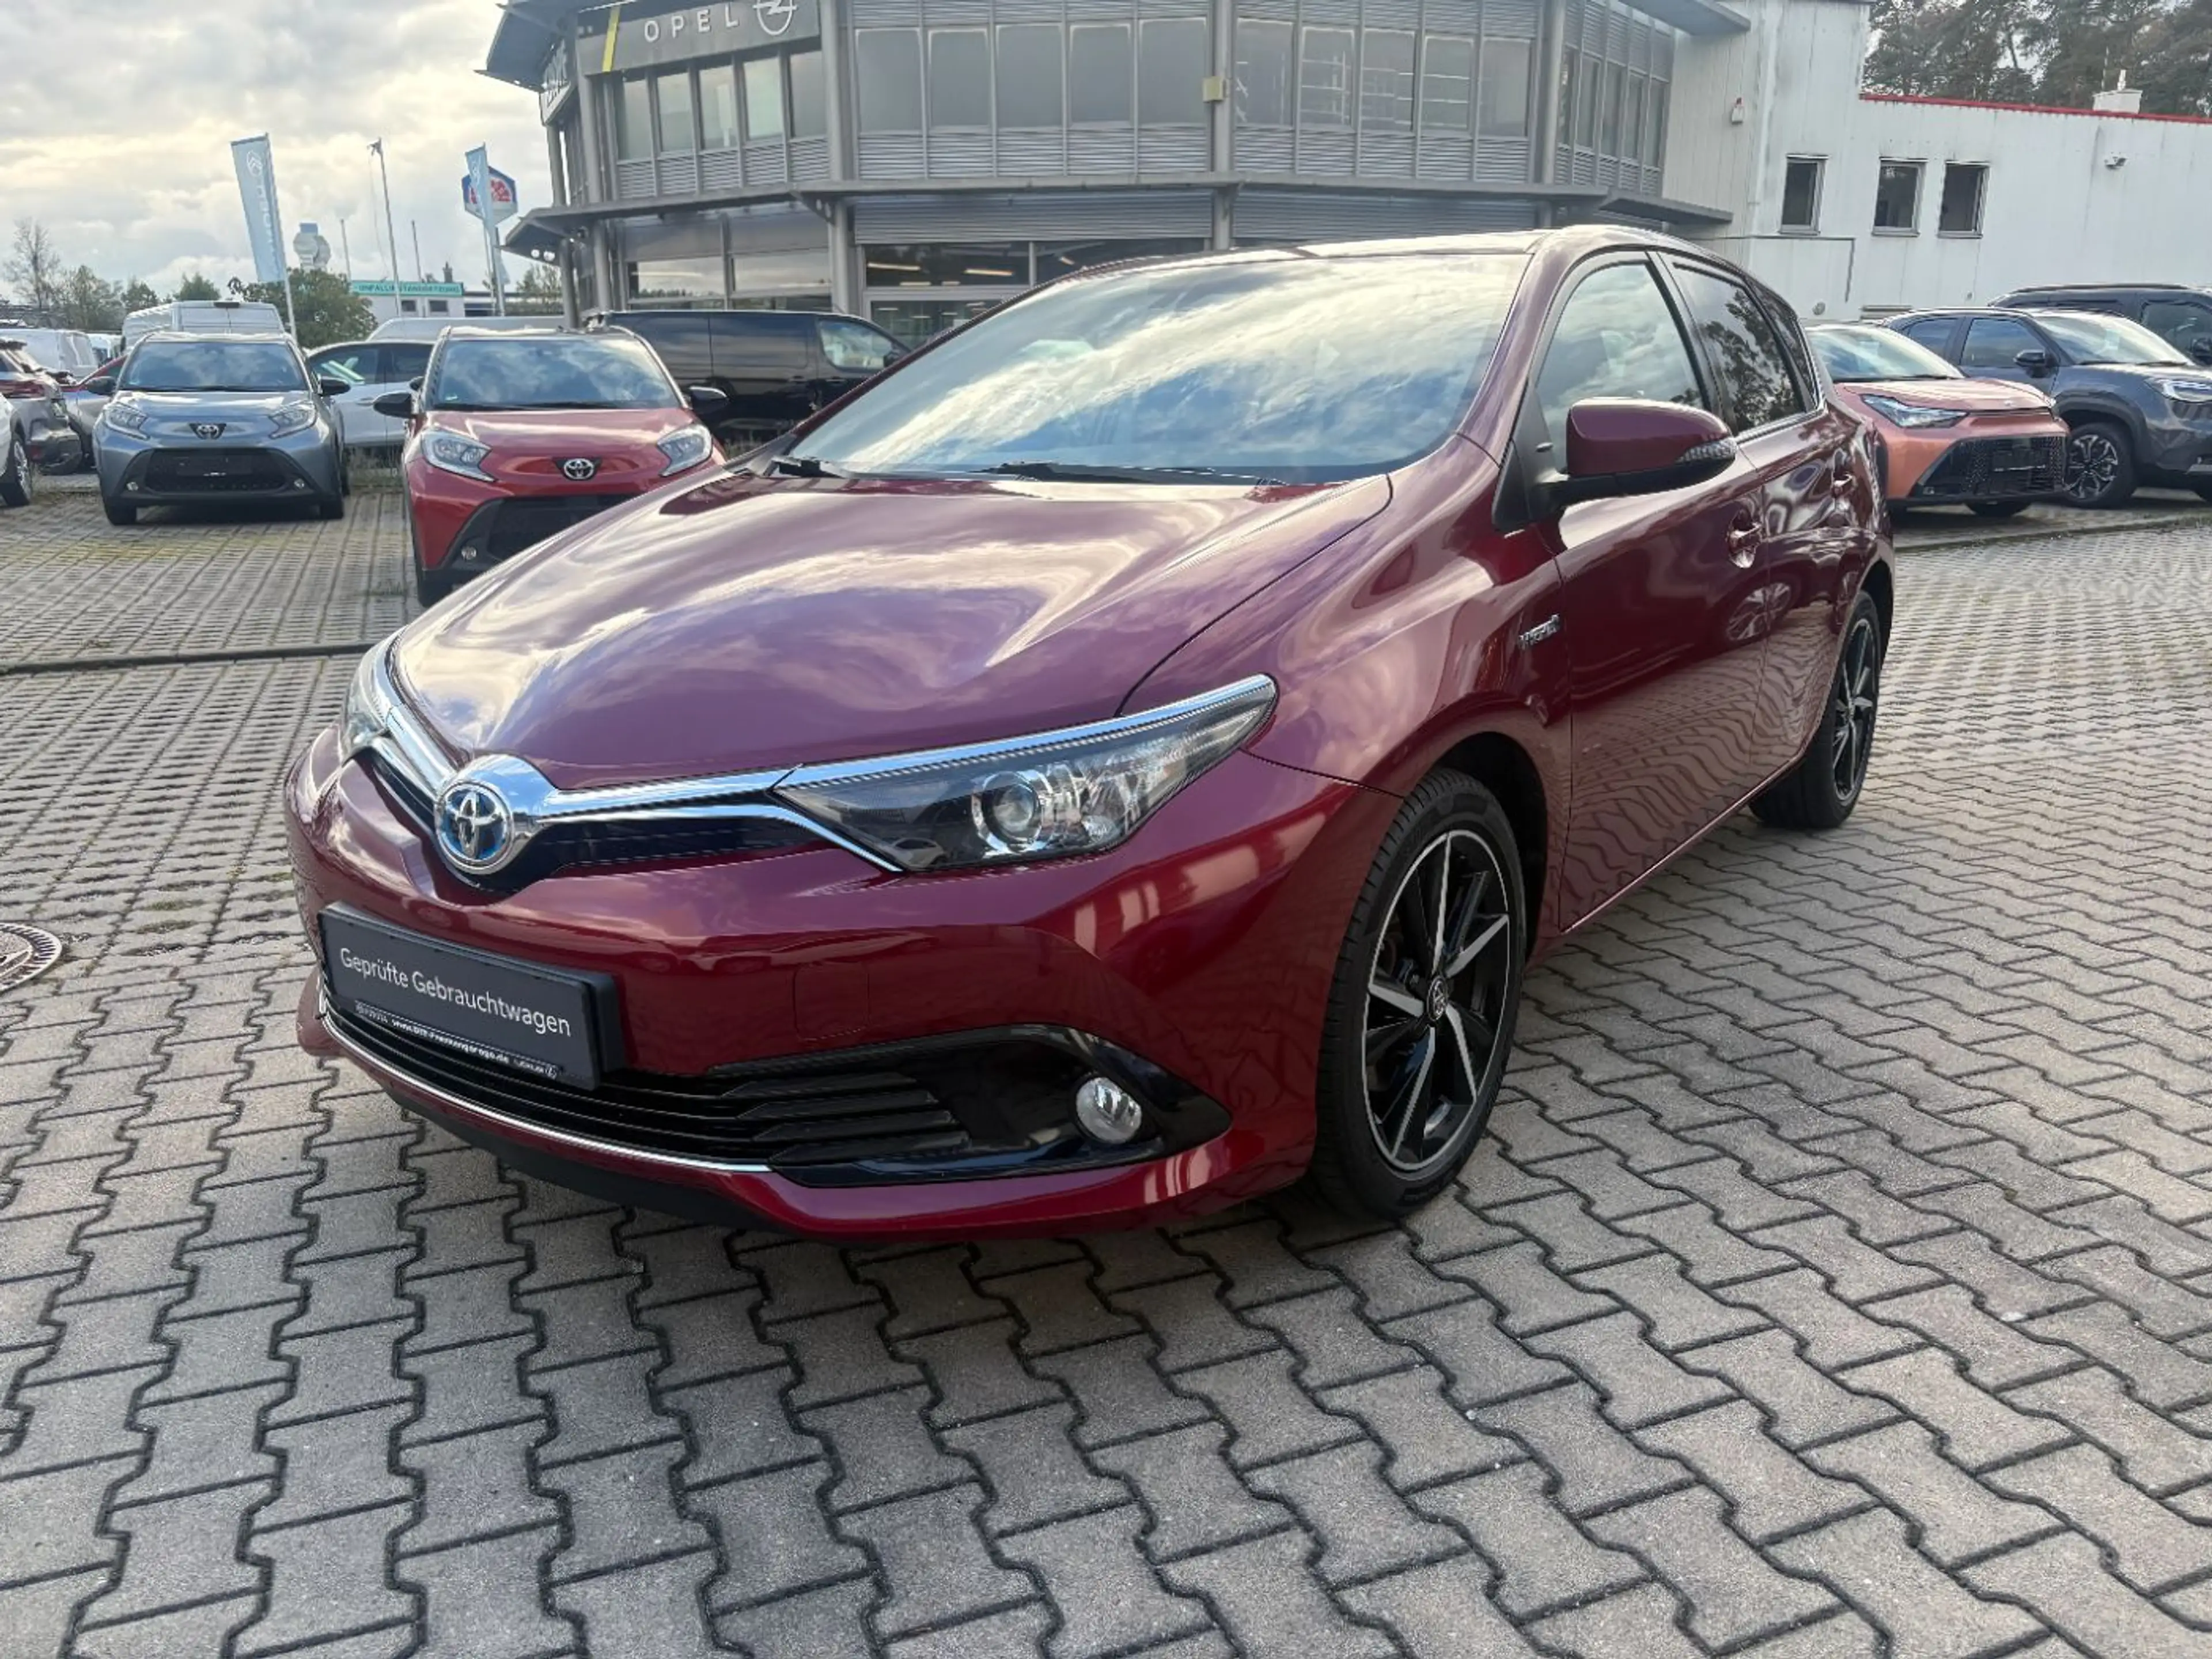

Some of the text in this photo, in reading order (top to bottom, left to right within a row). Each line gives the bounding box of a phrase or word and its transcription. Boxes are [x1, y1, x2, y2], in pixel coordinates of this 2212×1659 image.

[643, 3, 739, 43] OPEL
[340, 947, 571, 1037] Geprüfte Gebrauchtwagen
